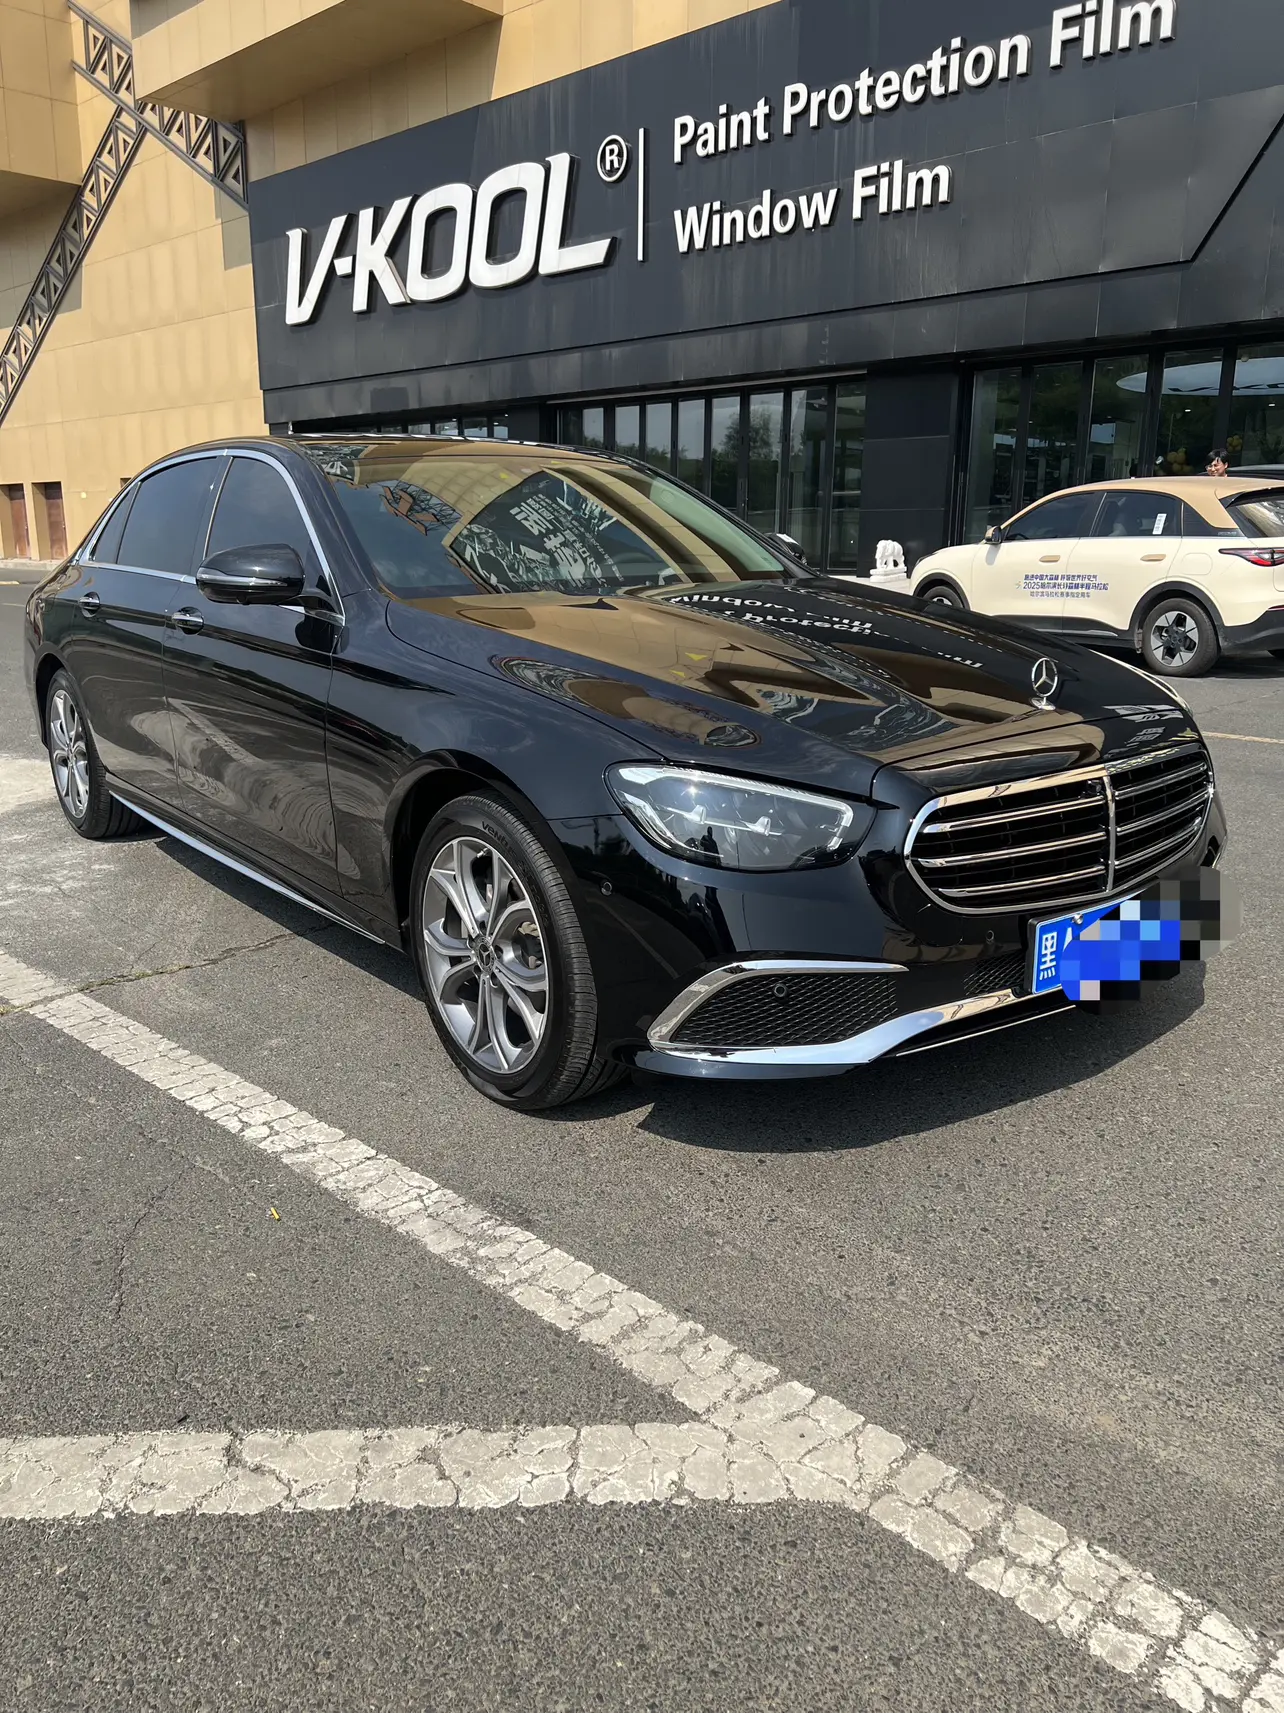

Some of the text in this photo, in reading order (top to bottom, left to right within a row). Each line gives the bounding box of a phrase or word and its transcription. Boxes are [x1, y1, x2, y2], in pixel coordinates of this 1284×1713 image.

[673, 0, 1177, 164] Paint Protection Film
[285, 152, 617, 326] V-KOOL
[673, 158, 952, 253] Window Film
